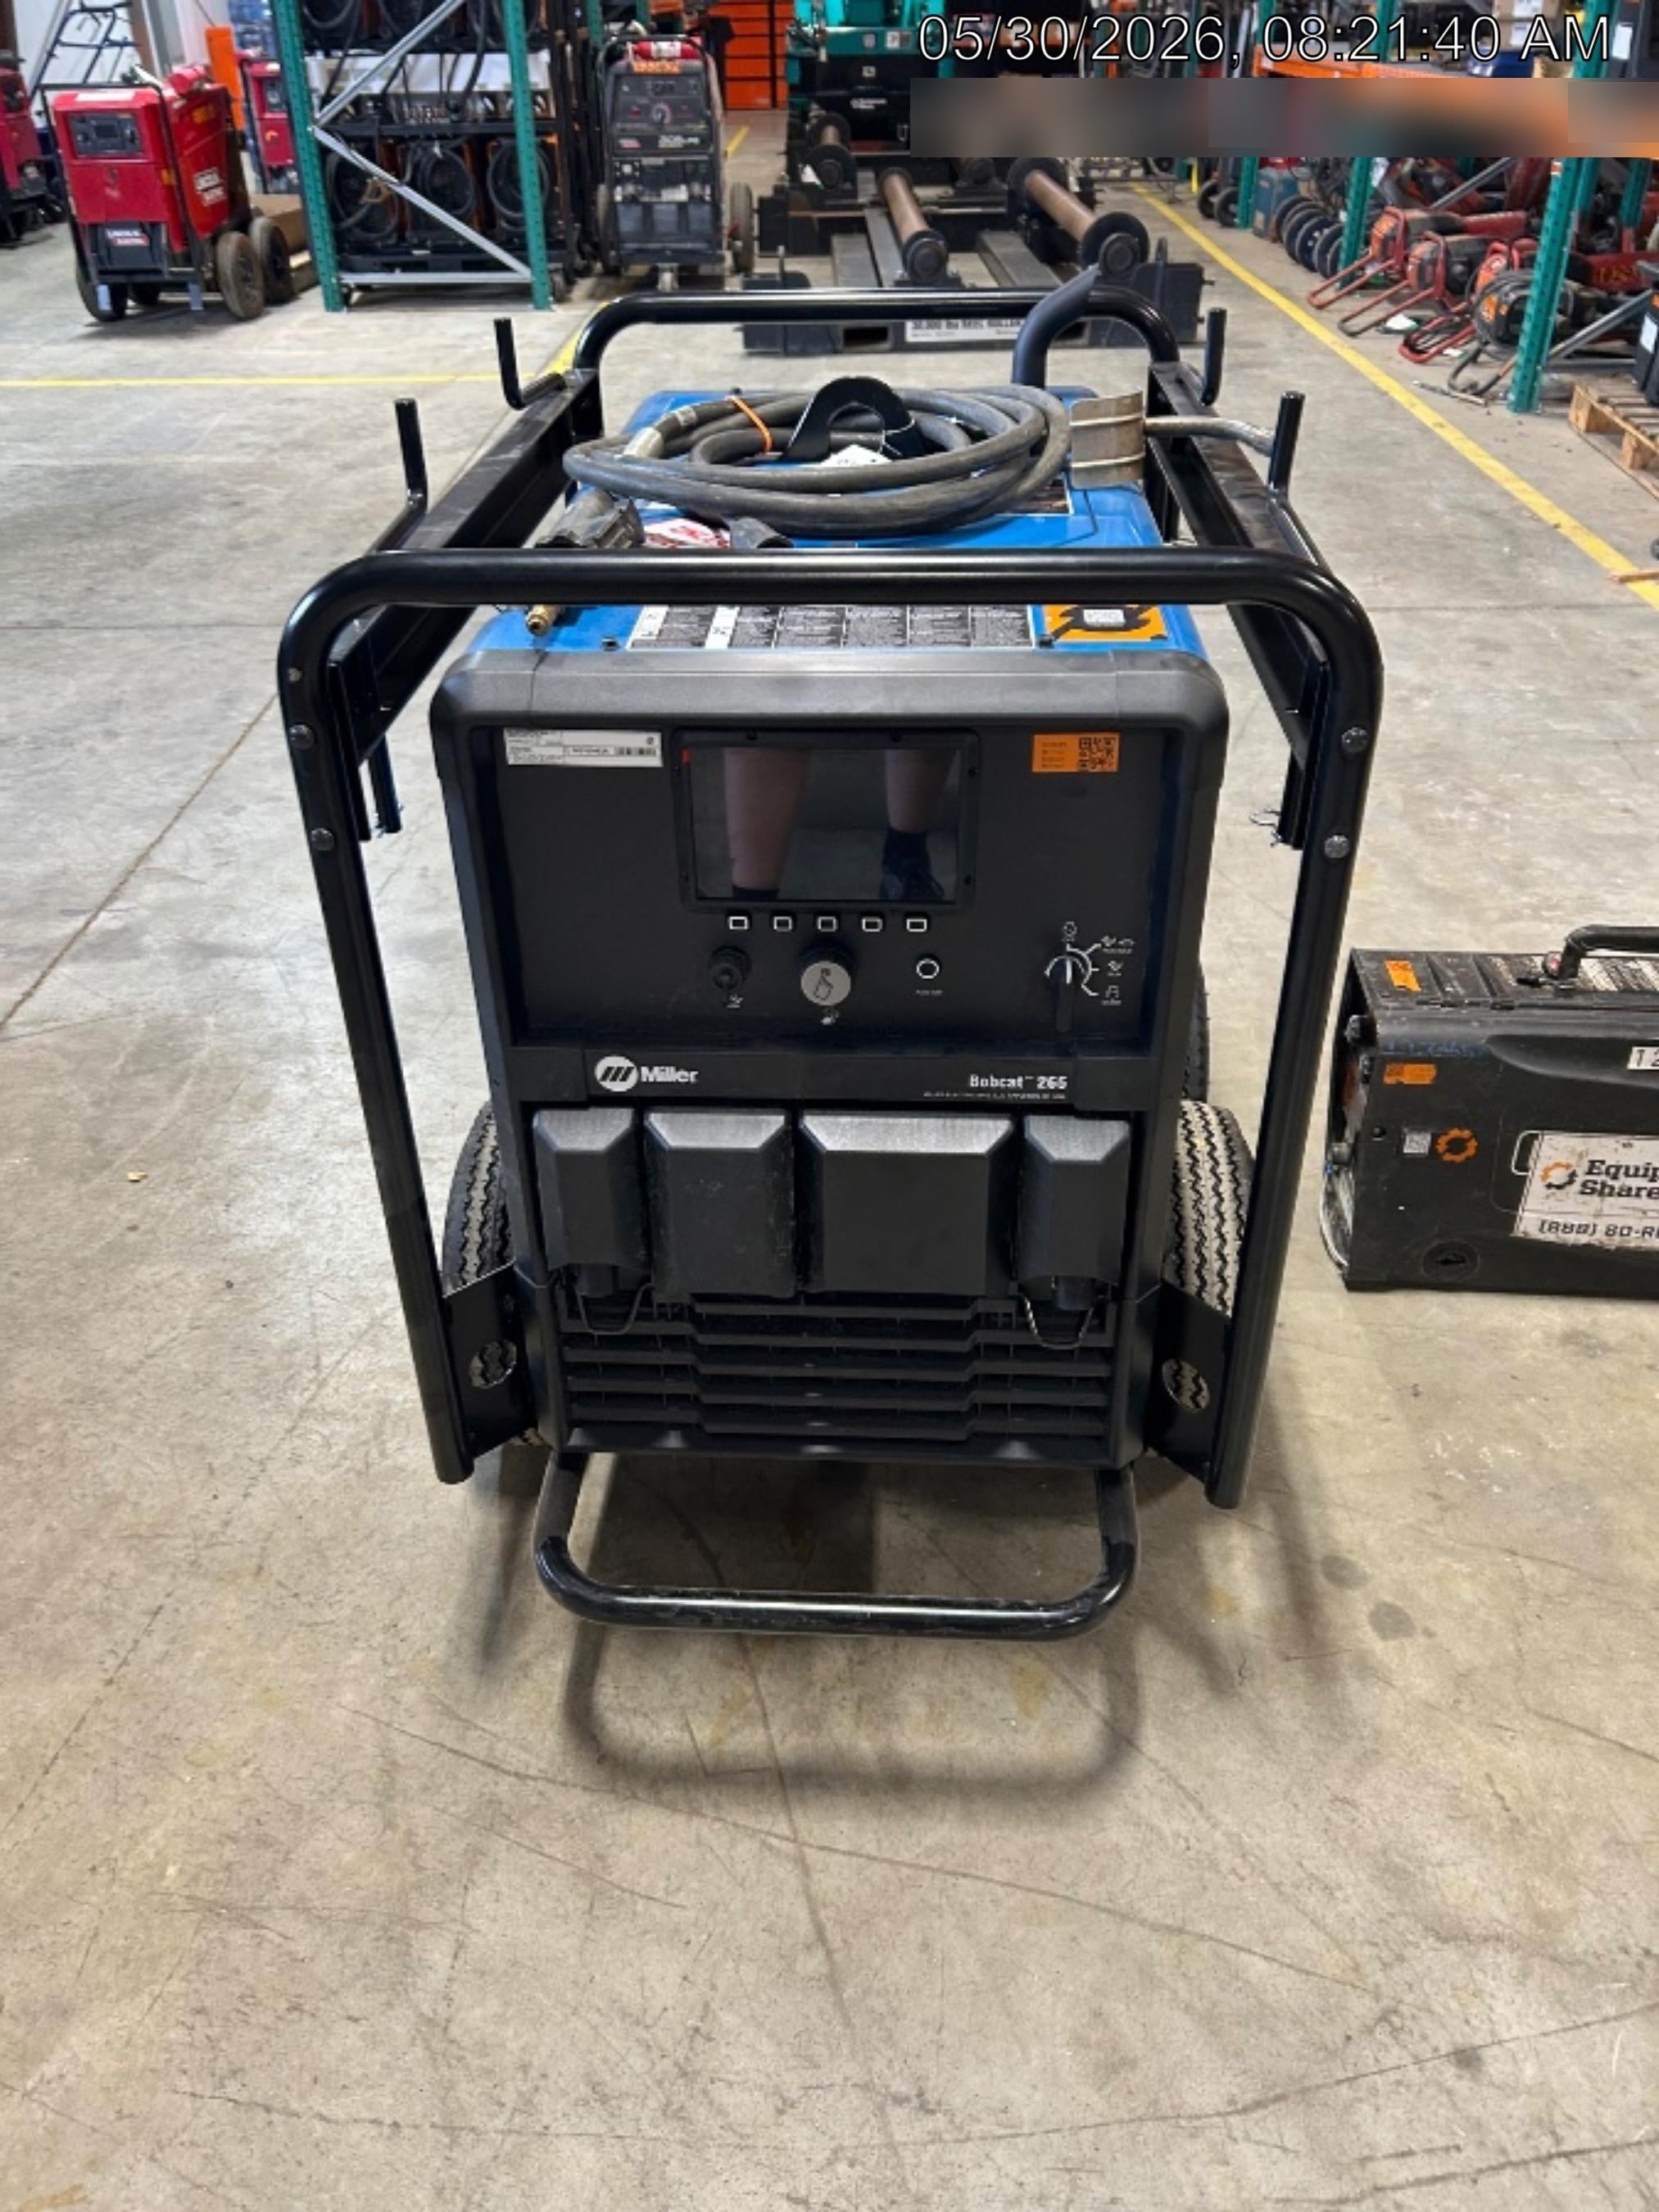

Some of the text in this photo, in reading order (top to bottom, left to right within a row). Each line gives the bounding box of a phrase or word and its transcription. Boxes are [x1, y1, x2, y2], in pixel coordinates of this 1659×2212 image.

[640, 1065, 699, 1083] Miller
[969, 1072, 1068, 1090] Bobcat 265
[1578, 1179, 1659, 1199] Share
